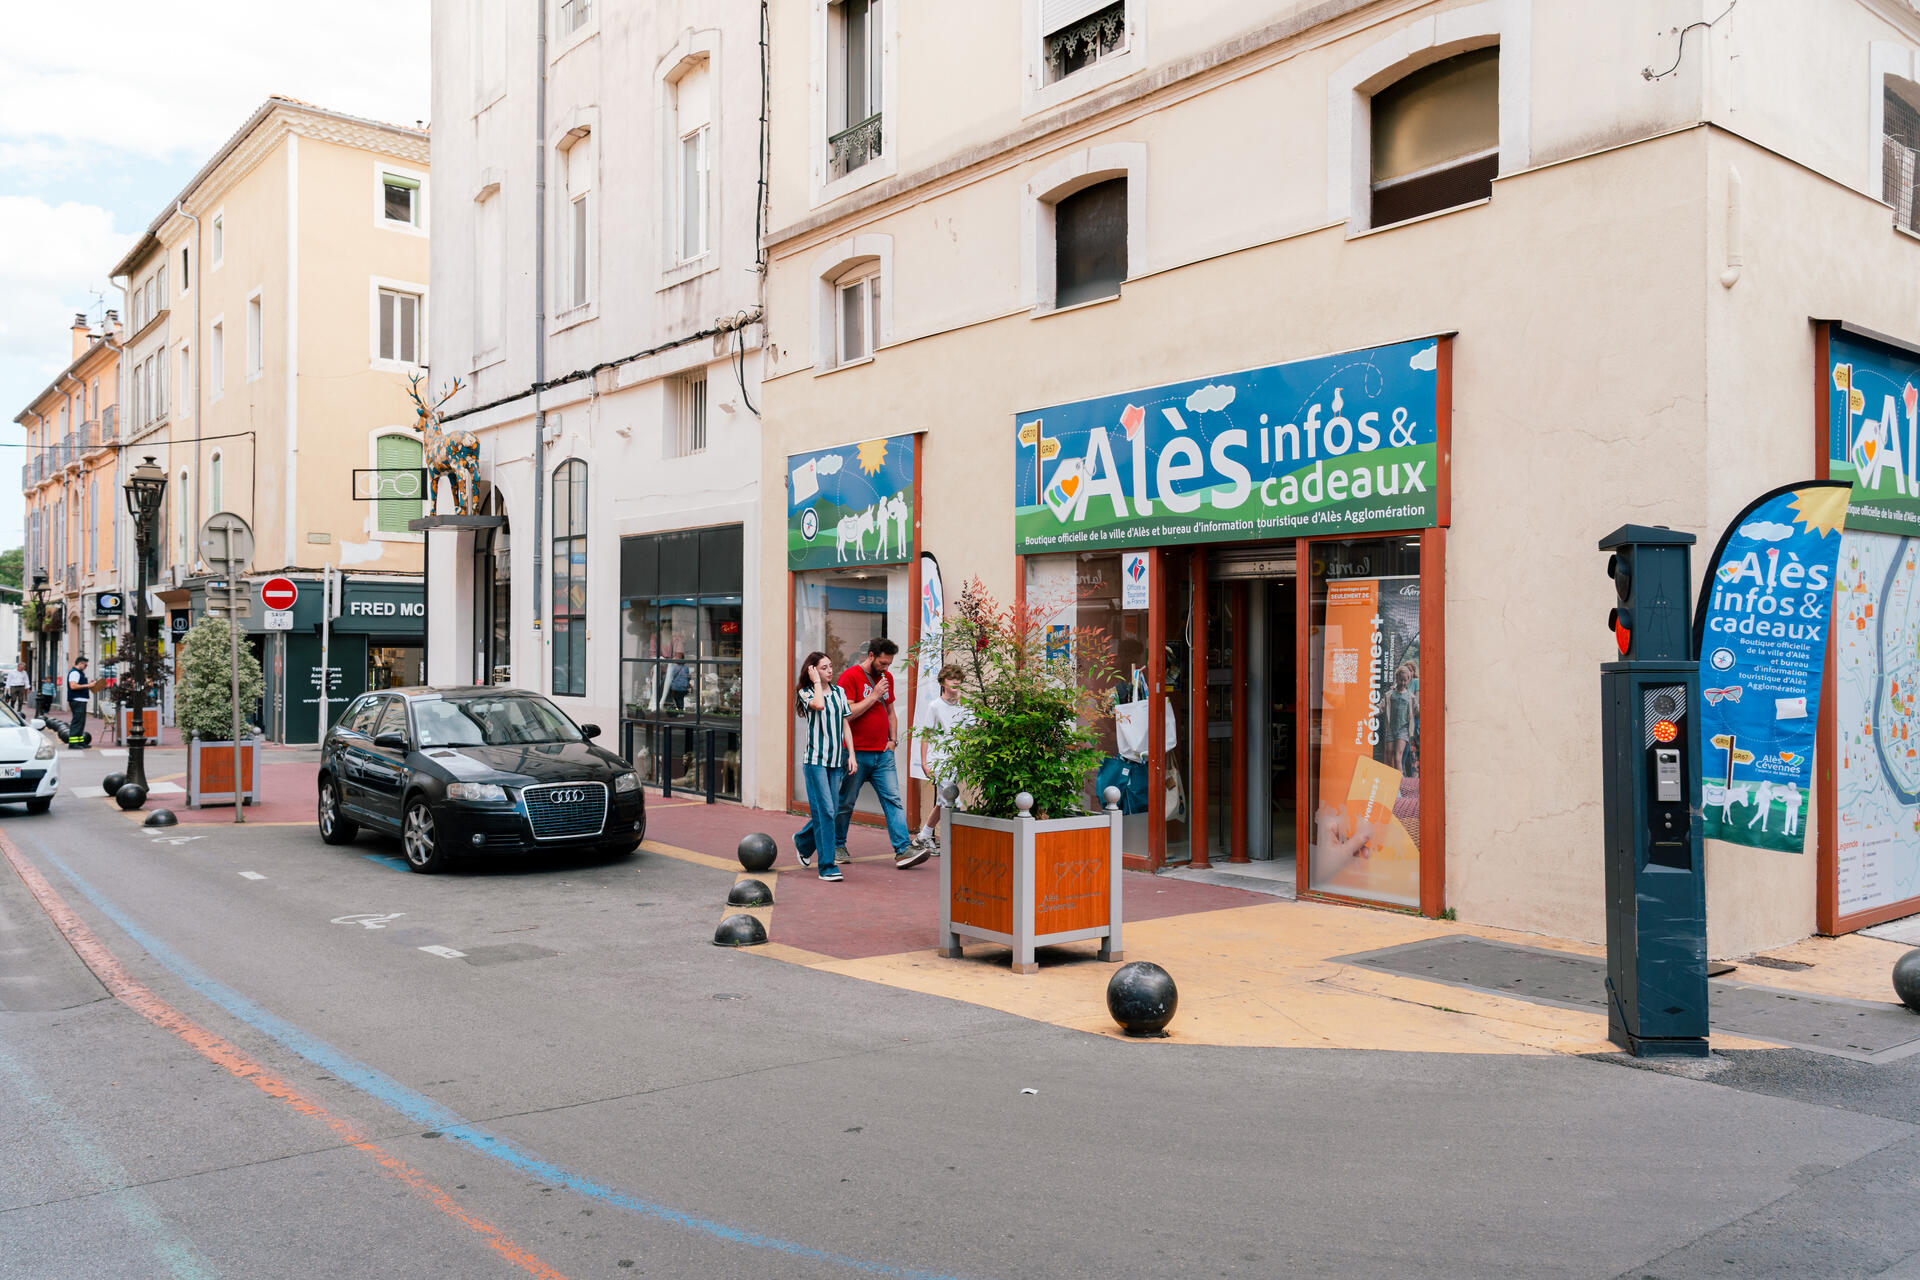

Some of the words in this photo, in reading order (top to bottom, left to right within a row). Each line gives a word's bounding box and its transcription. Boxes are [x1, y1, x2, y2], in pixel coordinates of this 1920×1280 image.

[1022, 428, 1036, 440] GR70
[1260, 404, 1380, 463] infos
[1389, 407, 1417, 447] &
[1041, 444, 1056, 456] GR67
[1073, 404, 1251, 522] Alès
[1260, 460, 1427, 506] cadeaux
[1881, 508, 1887, 518] de
[1888, 509, 1892, 519] la
[1026, 535, 1056, 546] Boutique
[1058, 532, 1088, 542] officielle
[1090, 530, 1098, 541] de
[1100, 530, 1108, 540] la
[1109, 528, 1125, 539] ville
[1127, 526, 1150, 537] d'Alès
[1152, 526, 1160, 536] et
[1162, 524, 1191, 536] bureau
[1194, 520, 1254, 532] d'information
[1257, 515, 1309, 530] touristique
[1312, 511, 1342, 524] d'Alès
[1344, 505, 1425, 524] Agglomération
[1731, 549, 1828, 591] Alès
[1714, 585, 1795, 616] infos
[1800, 593, 1824, 619] &
[350, 602, 396, 616] FRED
[400, 602, 425, 617] MO
[1710, 614, 1821, 641] cadeaux
[1740, 638, 1775, 648] Boutique
[1776, 641, 1811, 651] officielle
[1786, 651, 1810, 659] d'Alès
[1781, 659, 1808, 668] bureau
[1754, 665, 1808, 677] d'information
[1364, 613, 1384, 746] cévennes+
[1739, 672, 1781, 683] touristique
[1783, 677, 1807, 685] d'Alès
[1747, 682, 1806, 693] Agglomération
[1762, 754, 1782, 764] Alès
[1756, 760, 1800, 773] Cévennes
